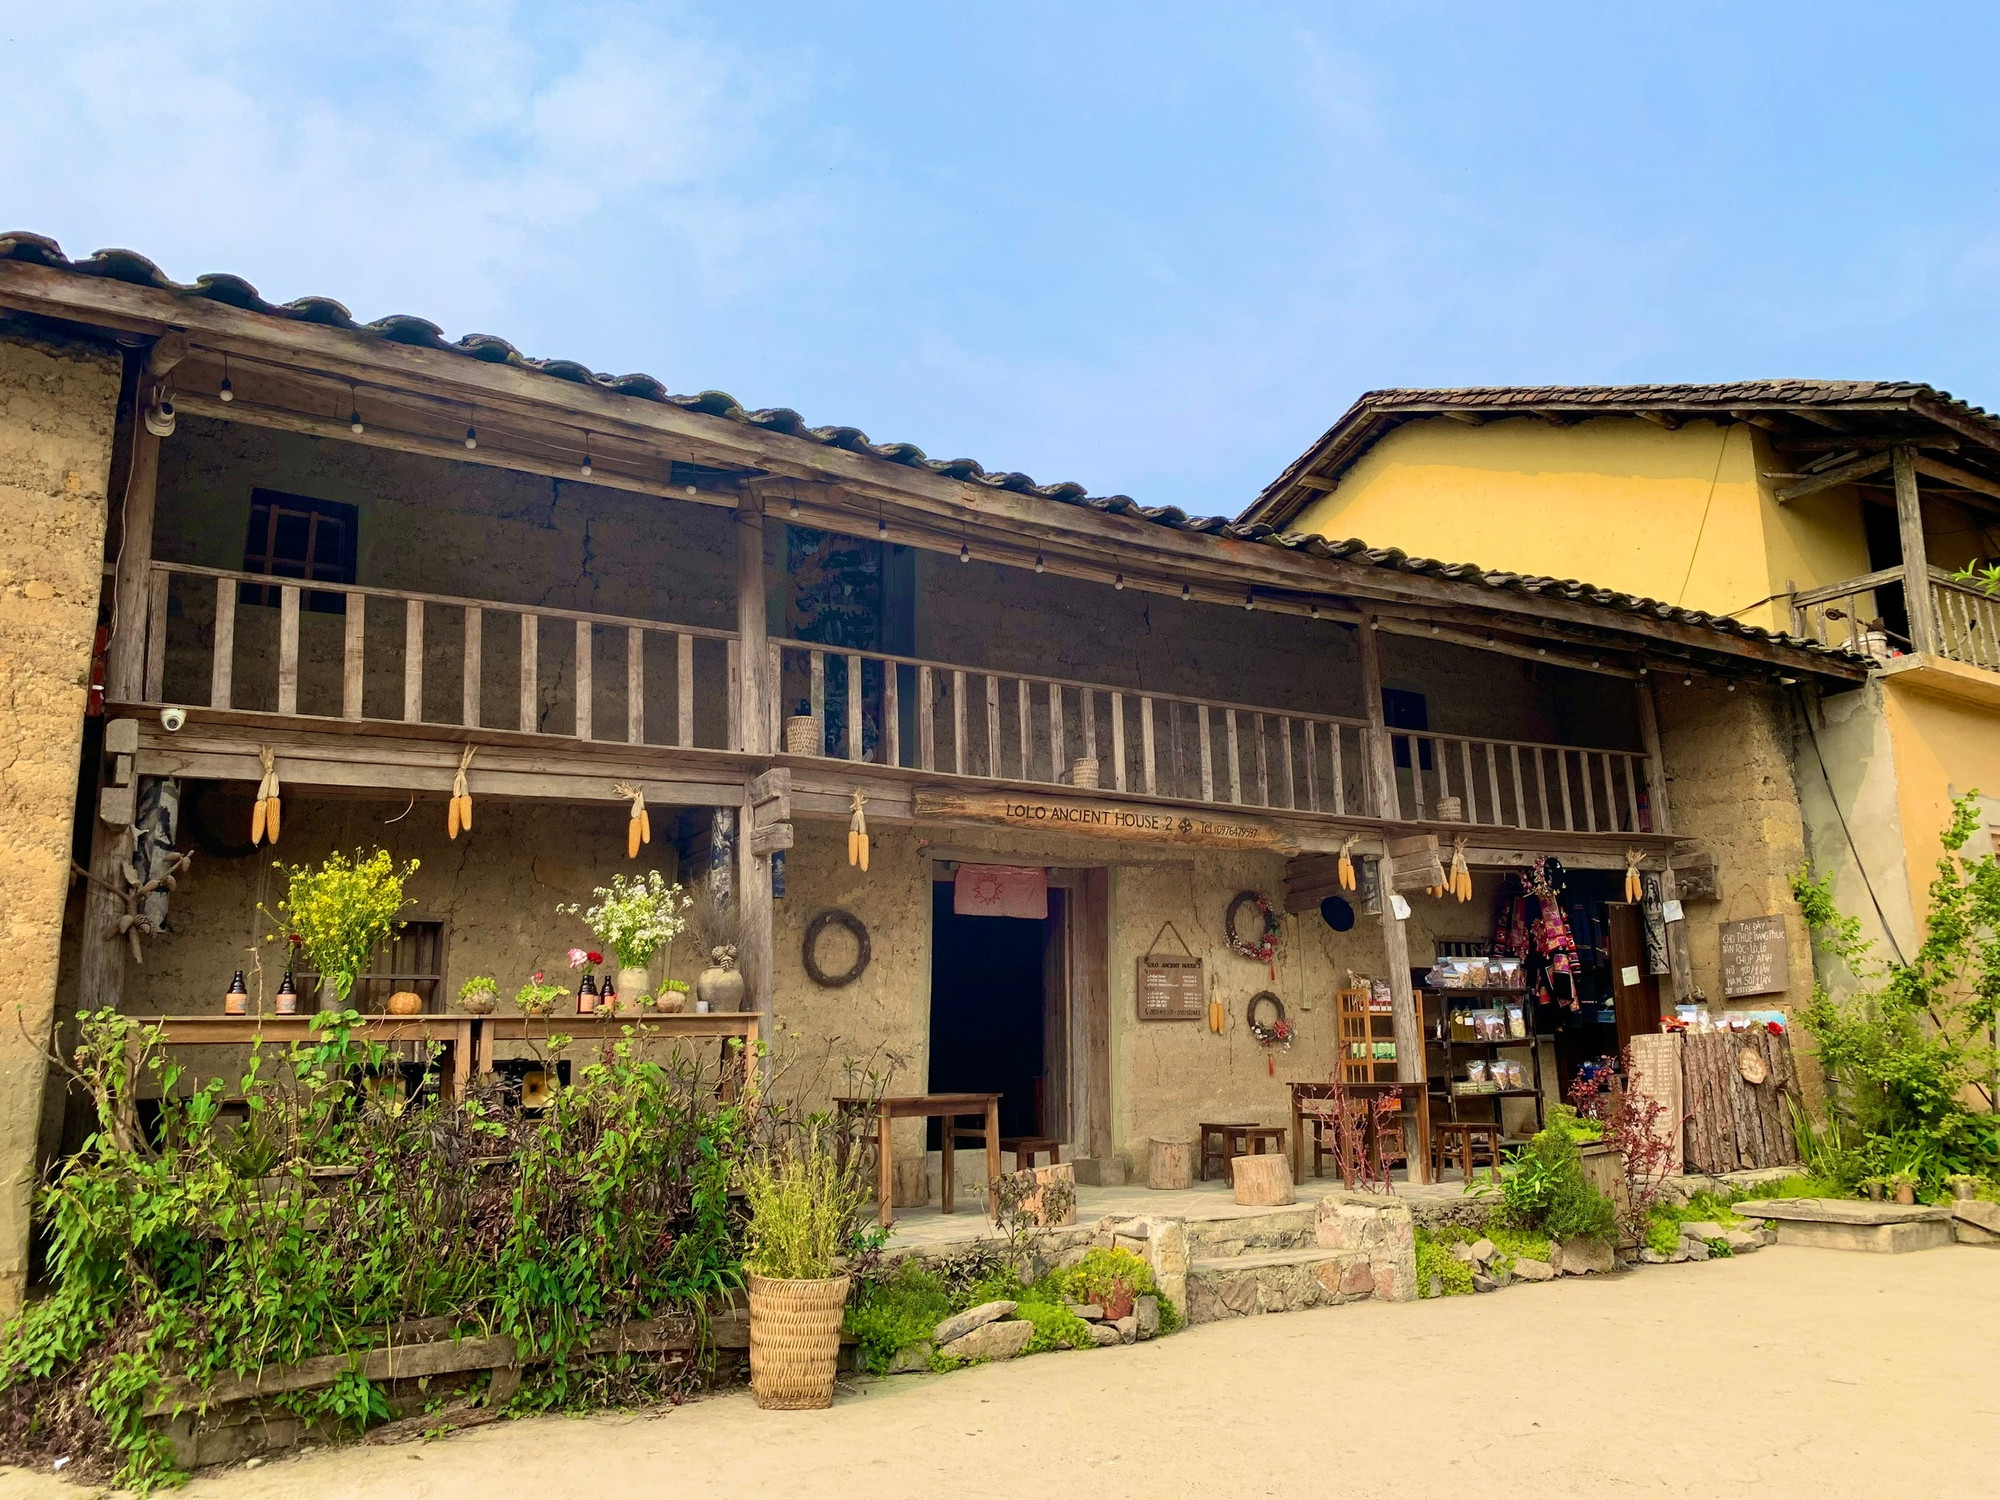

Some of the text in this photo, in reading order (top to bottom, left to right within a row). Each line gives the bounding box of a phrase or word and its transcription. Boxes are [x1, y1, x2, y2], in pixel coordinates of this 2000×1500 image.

[1006, 804, 1046, 820] LOLO
[1050, 807, 1110, 825] ANCIENT
[1115, 812, 1159, 829] HOUSE
[1165, 816, 1173, 831] 2
